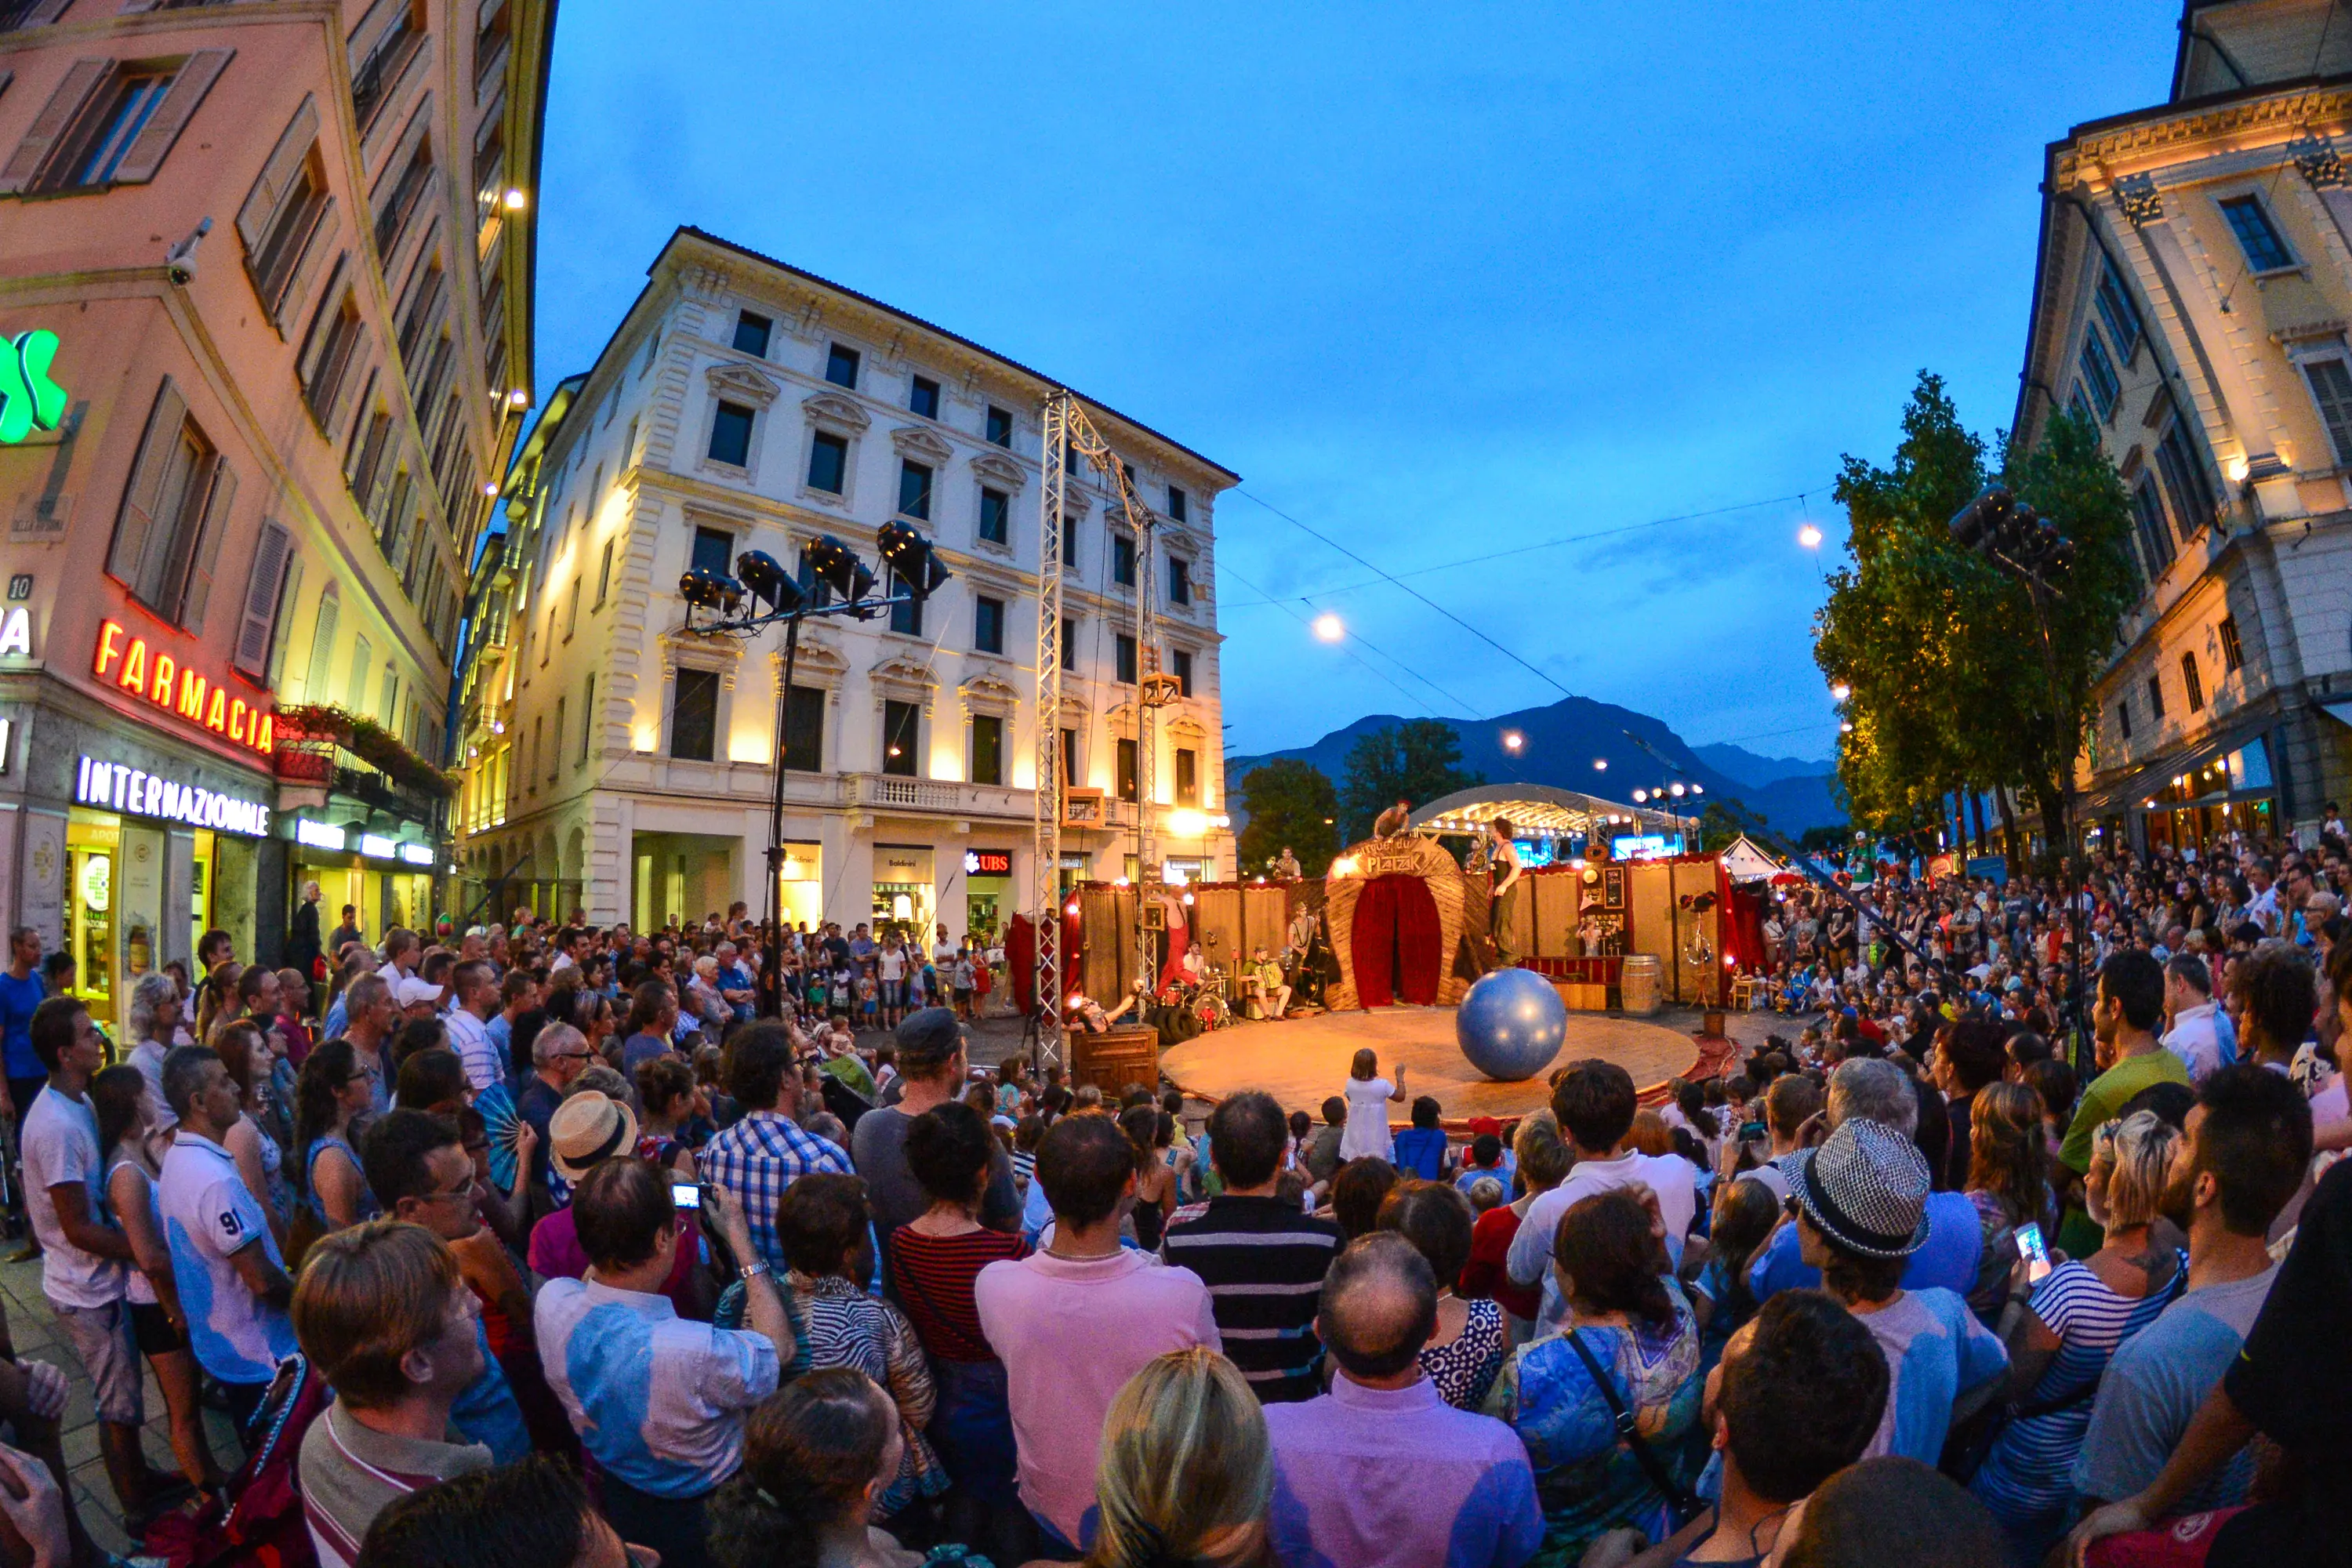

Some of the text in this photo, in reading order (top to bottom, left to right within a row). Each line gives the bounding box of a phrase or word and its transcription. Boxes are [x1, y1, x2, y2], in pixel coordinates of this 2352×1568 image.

[11, 578, 29, 598] 10
[95, 620, 273, 754] FARMACIA
[78, 755, 270, 837] INTERNAZIONALE
[1396, 837, 1410, 849] du
[786, 855, 815, 864] aldinini
[980, 855, 1008, 871] UBS
[220, 1207, 245, 1236] 91
